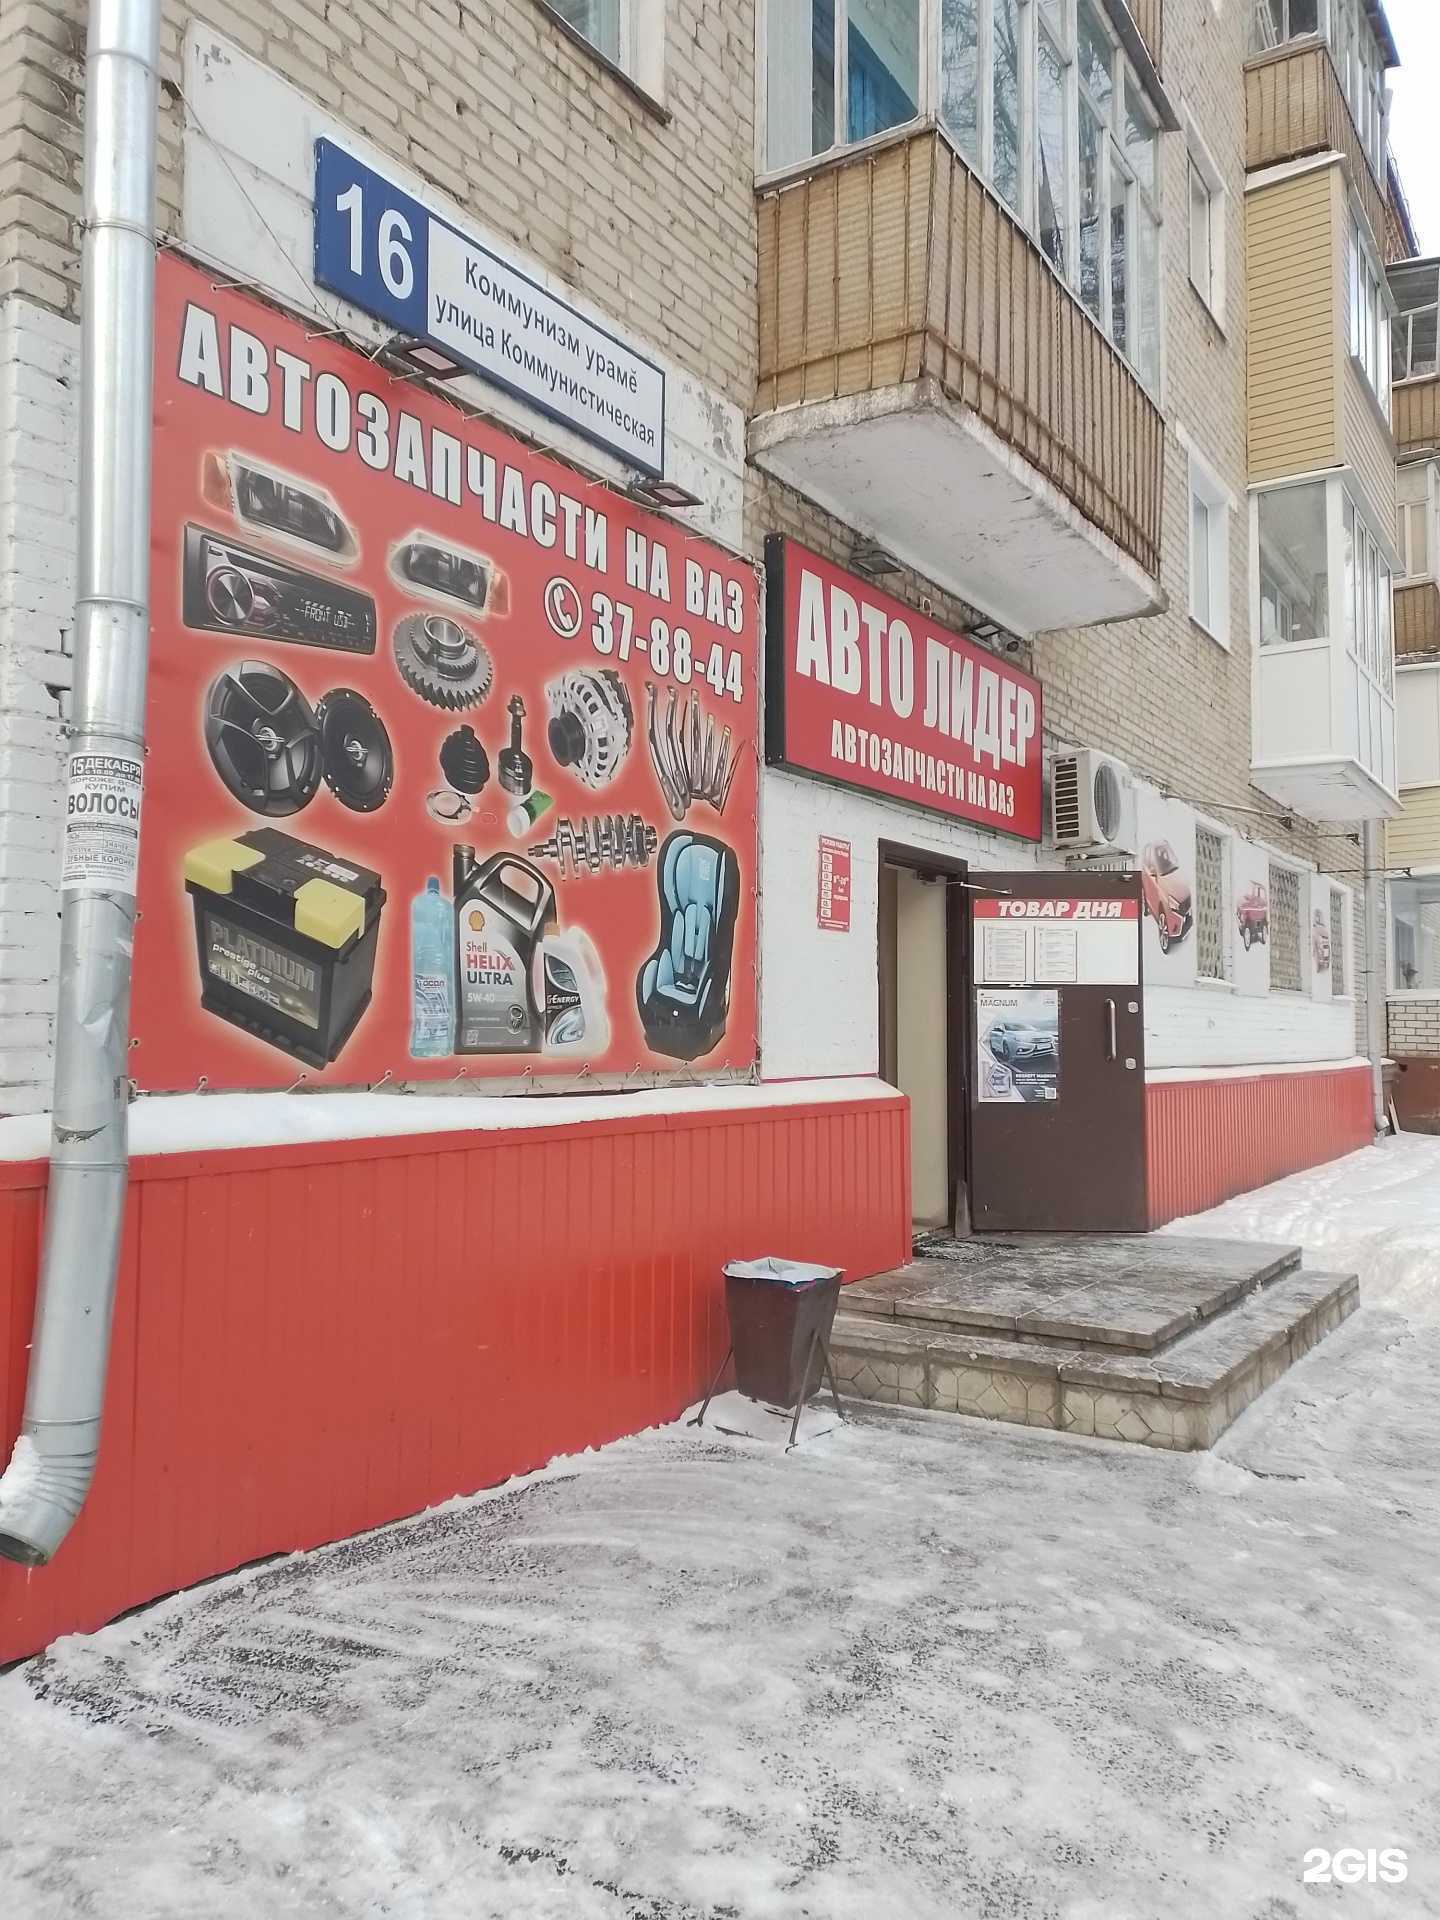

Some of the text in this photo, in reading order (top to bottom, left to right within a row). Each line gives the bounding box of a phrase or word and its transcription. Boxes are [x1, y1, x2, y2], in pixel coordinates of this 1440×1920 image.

[336, 183, 414, 300] 16
[465, 256, 580, 357] Коммунизм
[435, 293, 656, 447] улица Коммунистическая
[177, 302, 744, 635] АВТОЗАПЧАСТИ НА ВАЗ
[591, 591, 744, 703] 37-88-44
[795, 568, 1036, 770] АВТО ЛИДЕР
[72, 758, 141, 776] 15 ДЕКАБРЯ
[831, 719, 1015, 818] АВТОЗАПЧАСТИ НА ВАЗ
[85, 783, 126, 793] КУПИМ
[68, 793, 140, 820] ВОЛОСЫ
[998, 901, 1123, 919] ТОВАР ДНЯ
[210, 920, 315, 992] PLATINUM
[212, 943, 257, 971] prestige
[466, 941, 488, 953] Shell
[247, 967, 271, 984] plus
[466, 953, 514, 971] HELIX
[467, 971, 513, 985] ULTRA
[980, 999, 1018, 1007] MAGNUM
